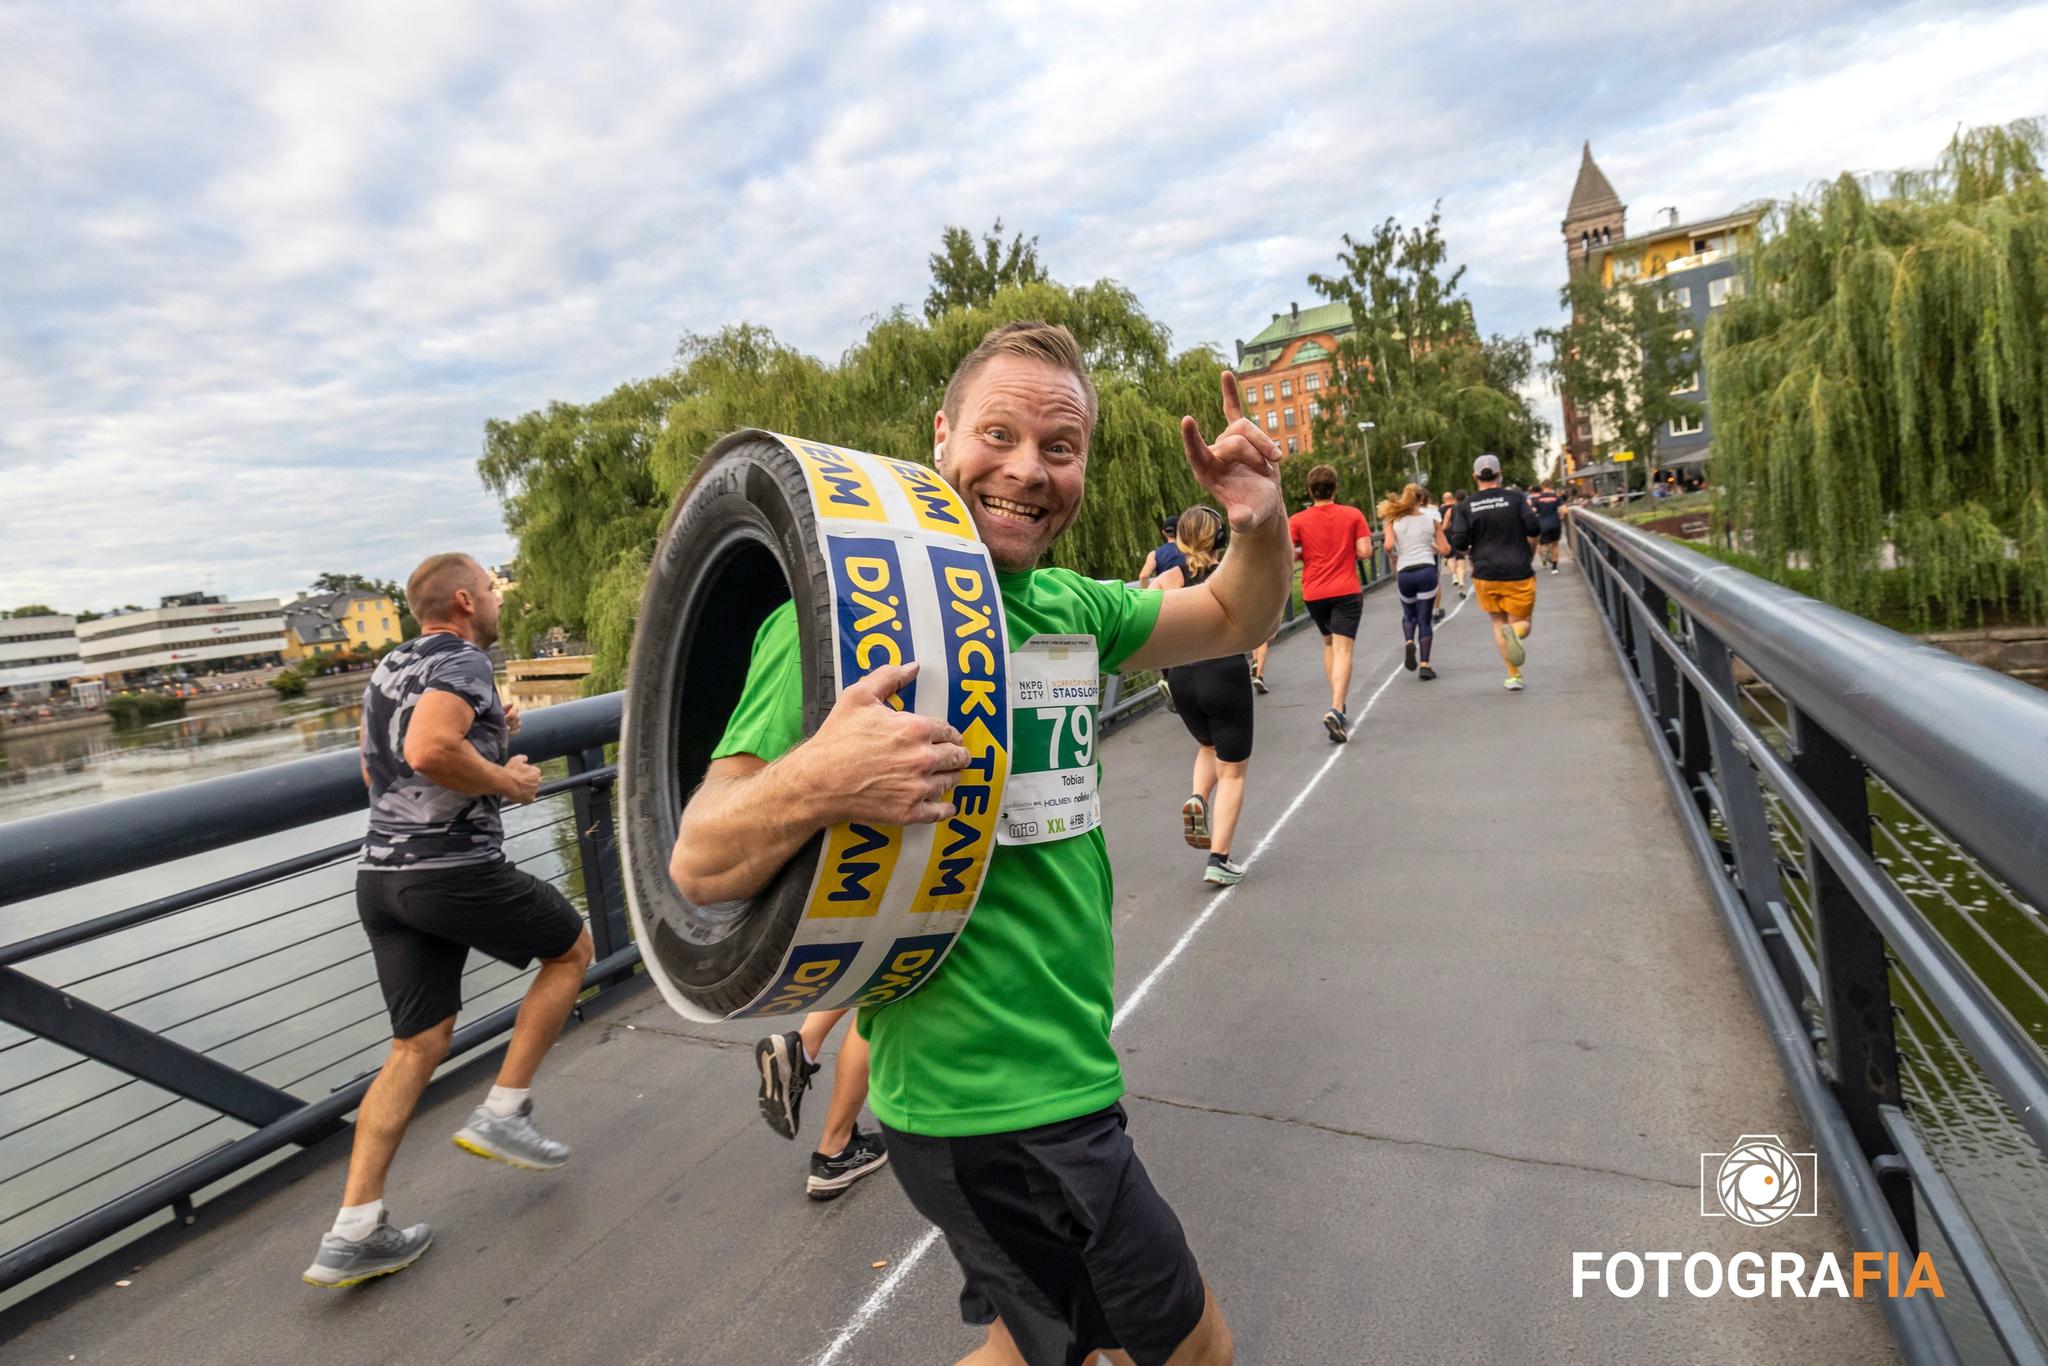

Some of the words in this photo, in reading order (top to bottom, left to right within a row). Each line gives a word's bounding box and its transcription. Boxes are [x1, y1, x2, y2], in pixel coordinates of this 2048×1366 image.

[845, 556, 904, 711] DÄC
[944, 566, 996, 717] DÄCK
[1019, 681, 1043, 690] NKPG
[1020, 690, 1044, 700] CITY
[1043, 797, 1071, 808] HOLMEN
[1061, 775, 1085, 786] Tobias
[929, 745, 995, 897] TEAM
[1047, 818, 1065, 834] XXL
[828, 824, 889, 902] AM
[759, 959, 841, 1012] DÄC
[854, 948, 935, 1008] DÄC
